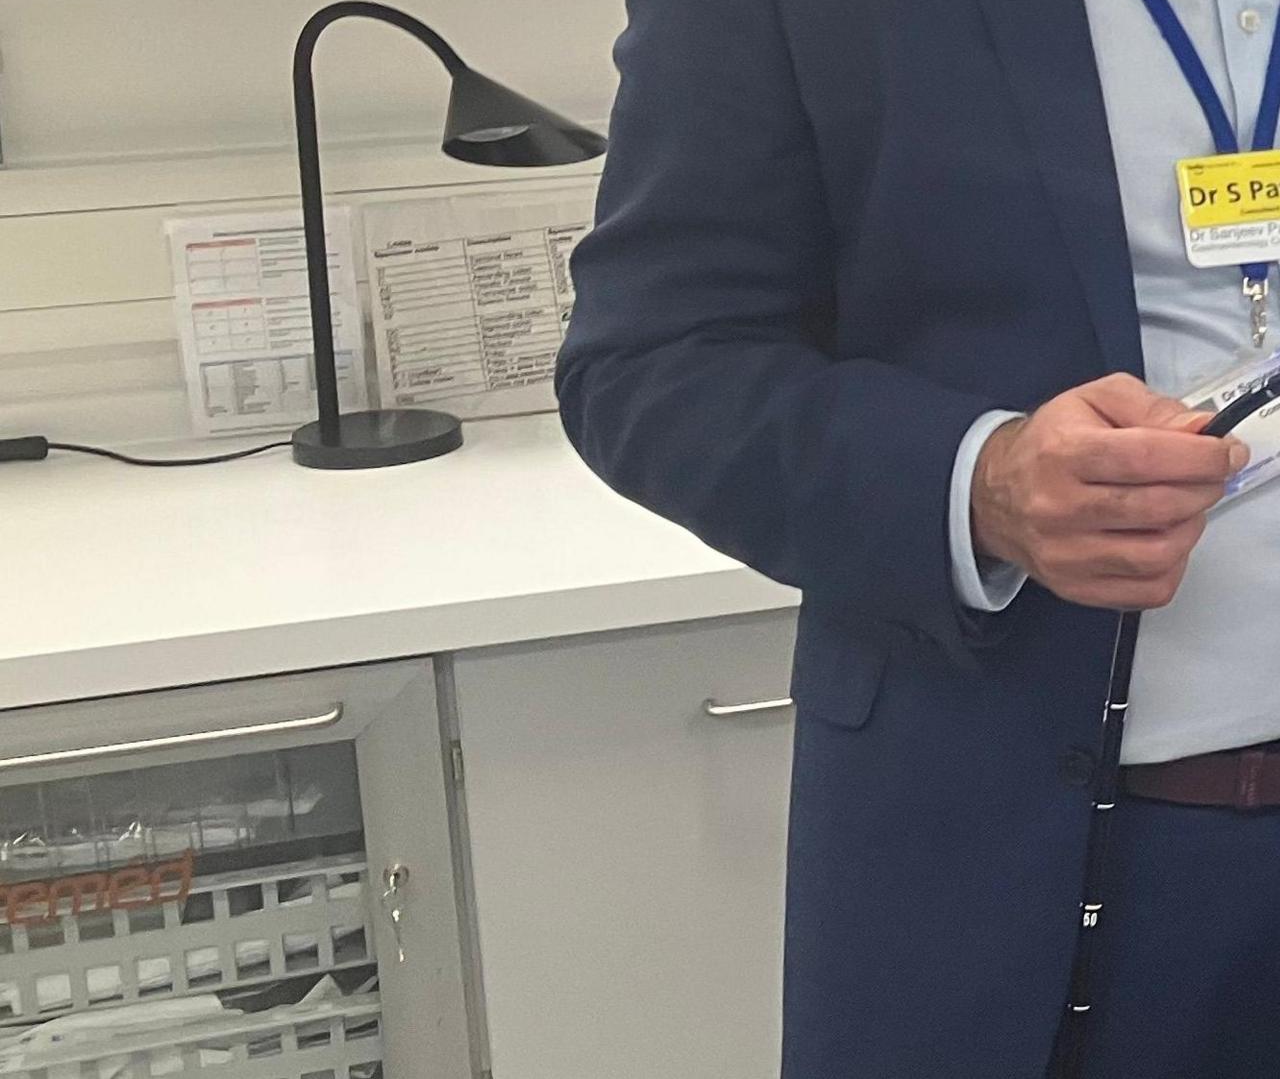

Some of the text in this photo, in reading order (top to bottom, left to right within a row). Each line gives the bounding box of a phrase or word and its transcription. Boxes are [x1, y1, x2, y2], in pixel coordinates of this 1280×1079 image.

[1189, 187, 1217, 208] Dr
[1227, 182, 1241, 204] S
[1190, 228, 1205, 243] Dr
